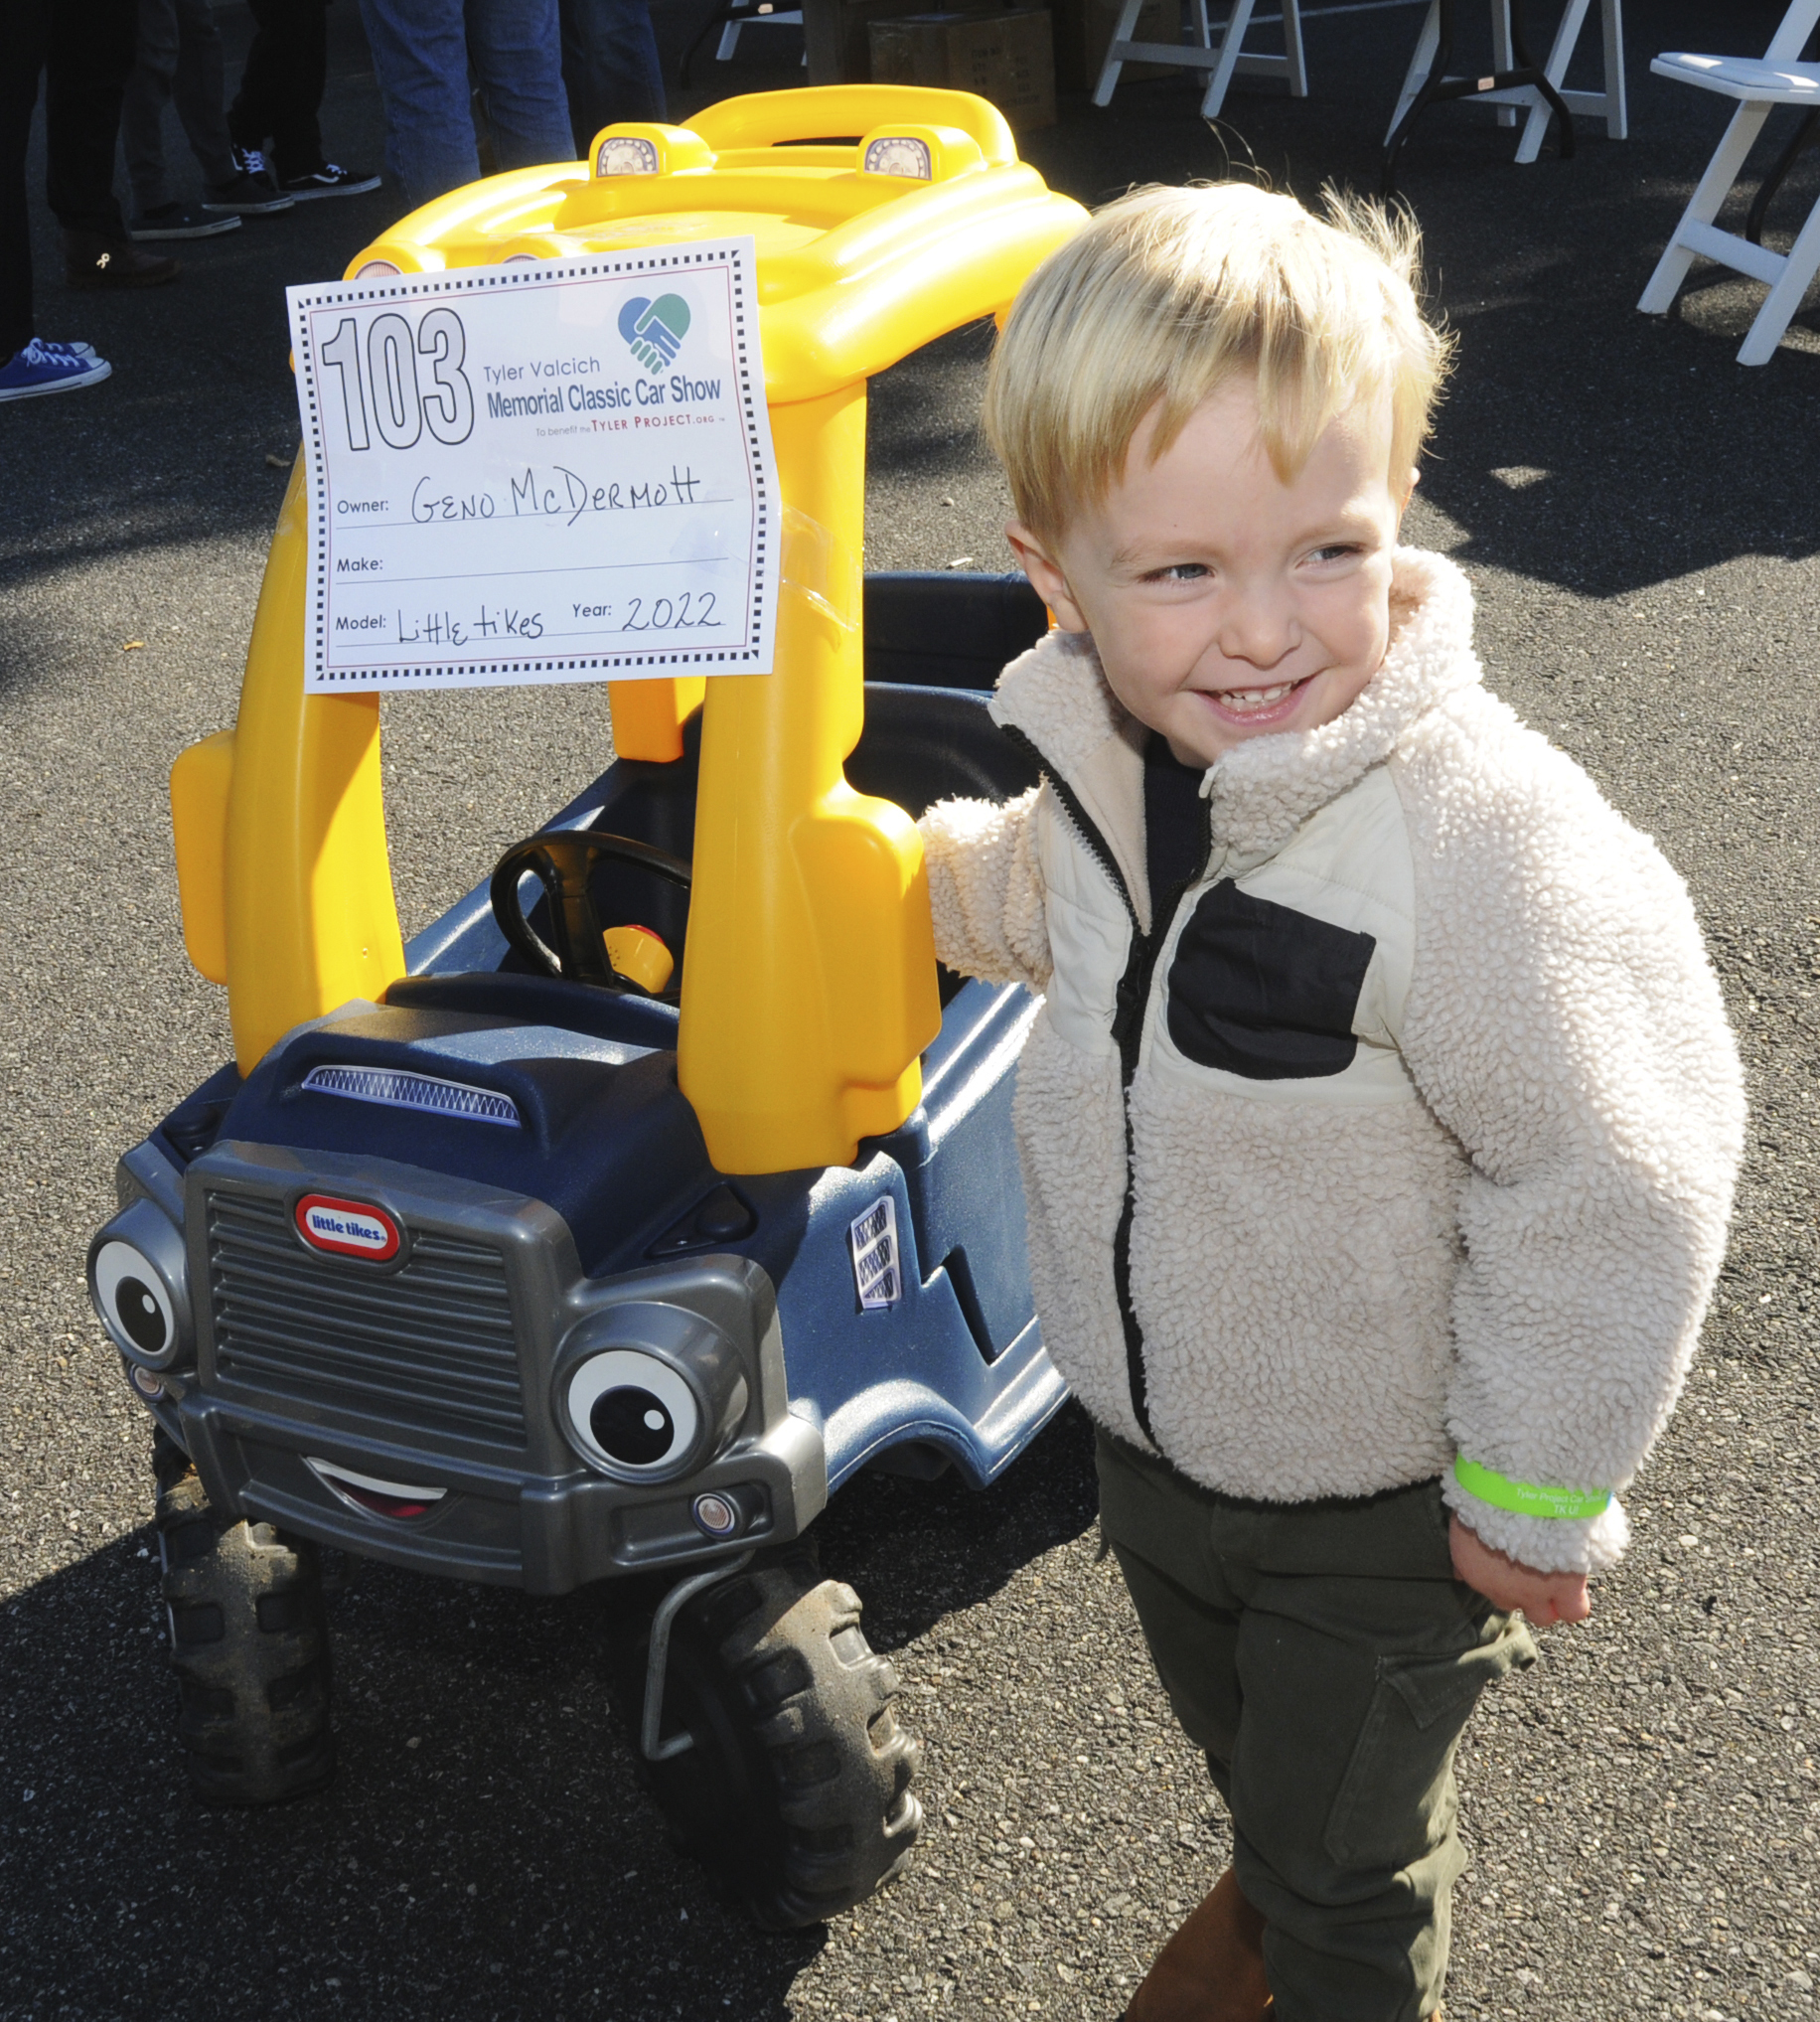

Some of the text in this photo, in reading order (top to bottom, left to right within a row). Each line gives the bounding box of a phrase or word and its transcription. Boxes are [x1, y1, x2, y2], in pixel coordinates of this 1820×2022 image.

[322, 307, 475, 451] 103
[484, 357, 601, 386] Tyler Valcich
[487, 375, 721, 418] Memorial Classic Car Show
[535, 428, 546, 437] To
[547, 424, 577, 436] benefit
[591, 419, 628, 432] TYLER
[337, 500, 389, 515] Owner:
[337, 557, 383, 572] Make:
[336, 614, 386, 631] Model:
[572, 603, 612, 617] Year:
[622, 591, 721, 631] 2022
[312, 1214, 345, 1234] little
